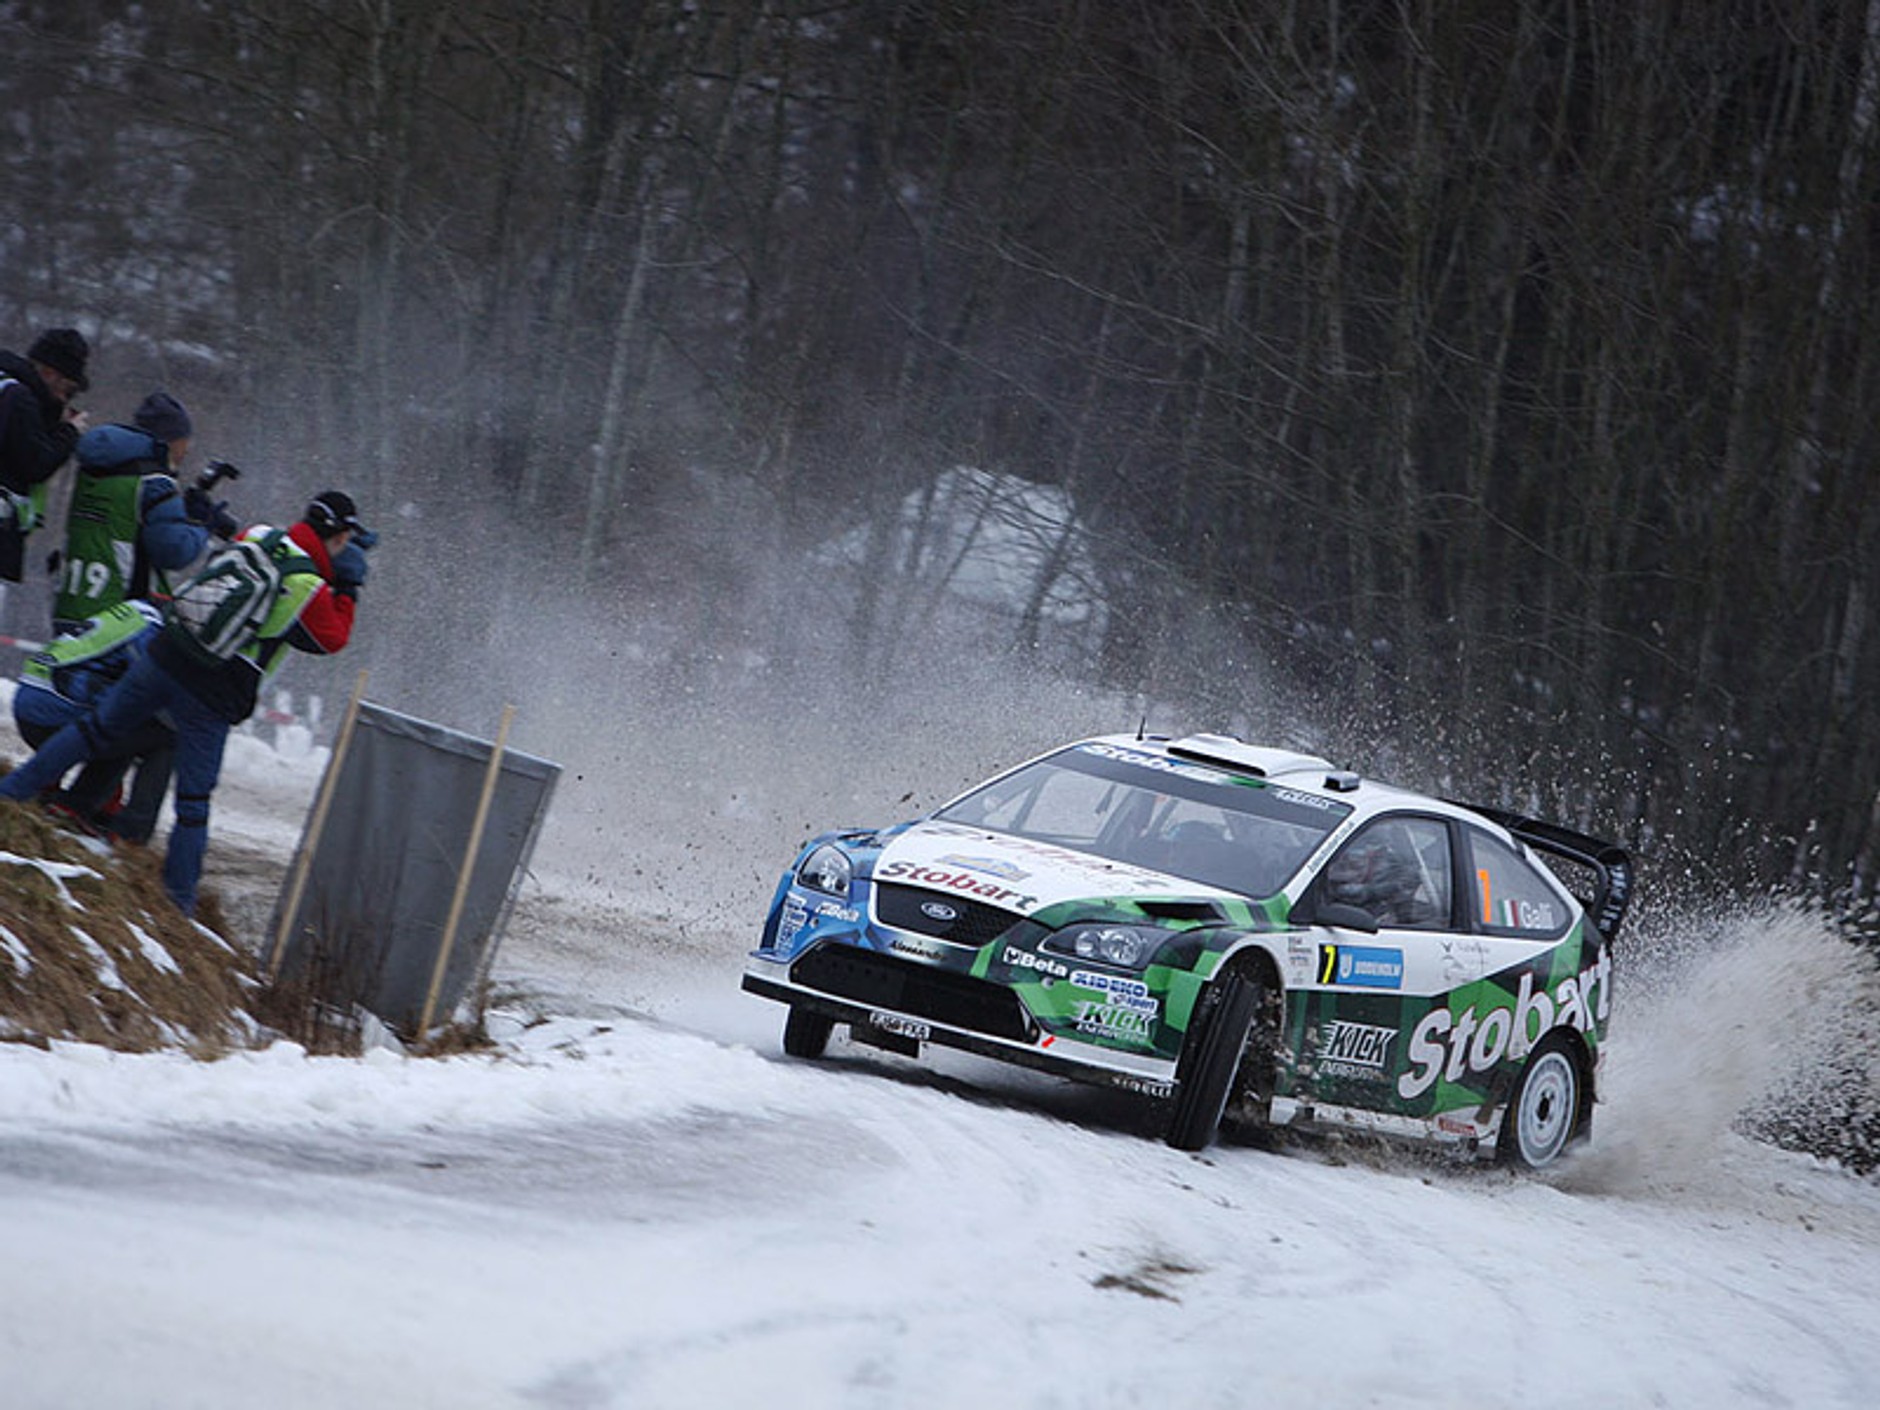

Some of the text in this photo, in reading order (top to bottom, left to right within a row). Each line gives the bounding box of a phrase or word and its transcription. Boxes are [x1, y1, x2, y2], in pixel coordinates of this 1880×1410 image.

[68, 559, 109, 598] 19
[879, 861, 1038, 910] Stobart
[1021, 954, 1068, 977] Beta
[1322, 944, 1336, 984] 7
[1398, 944, 1611, 1099] Stobart
